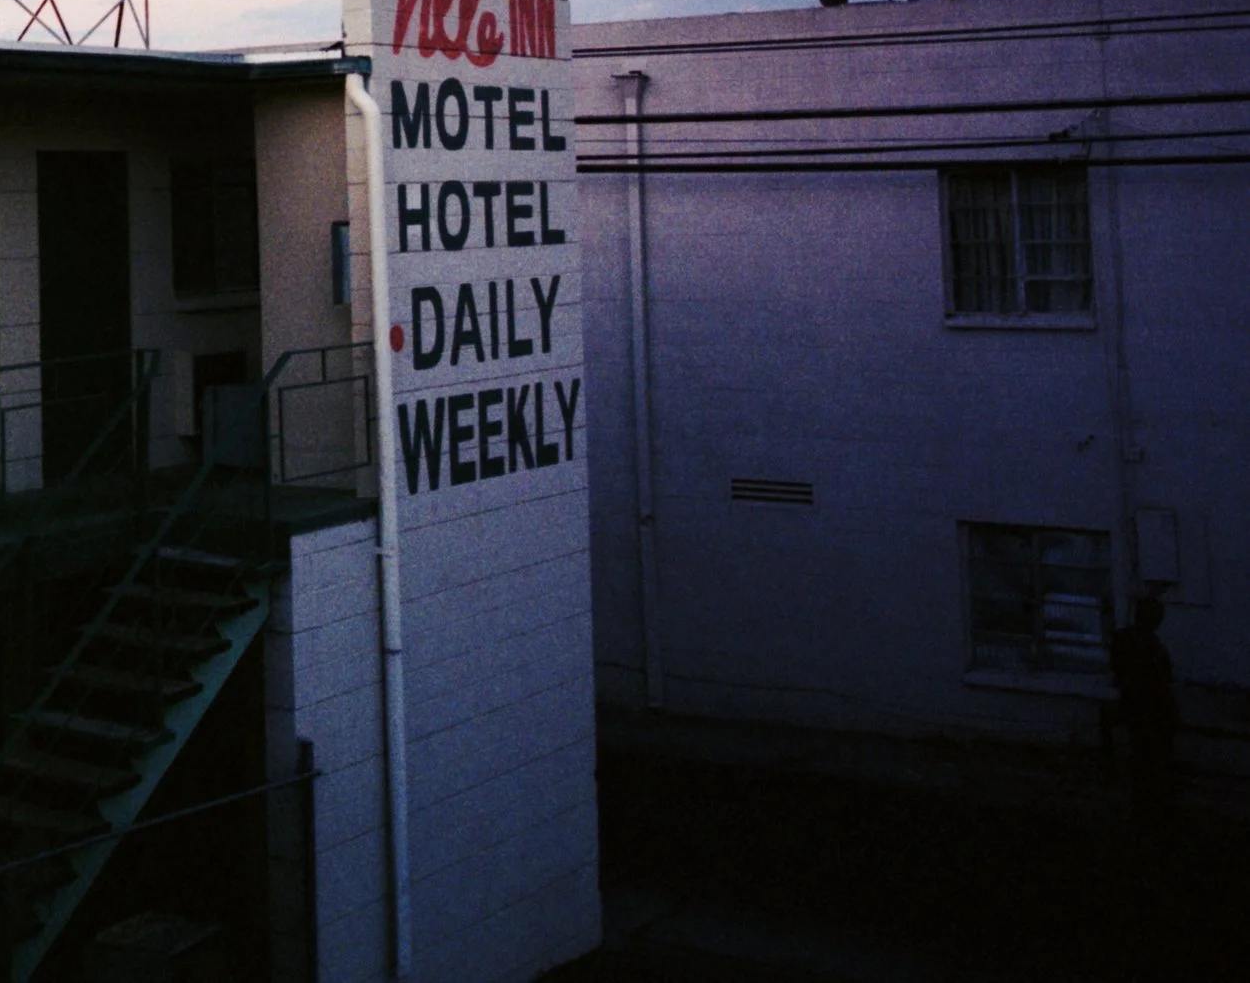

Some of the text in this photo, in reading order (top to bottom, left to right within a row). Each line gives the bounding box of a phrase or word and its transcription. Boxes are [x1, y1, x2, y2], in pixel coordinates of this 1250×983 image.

[390, 77, 566, 151] MOTEL
[397, 180, 565, 252] HOTEL
[411, 275, 561, 370] DAILY
[397, 378, 581, 495] WEEKLY
